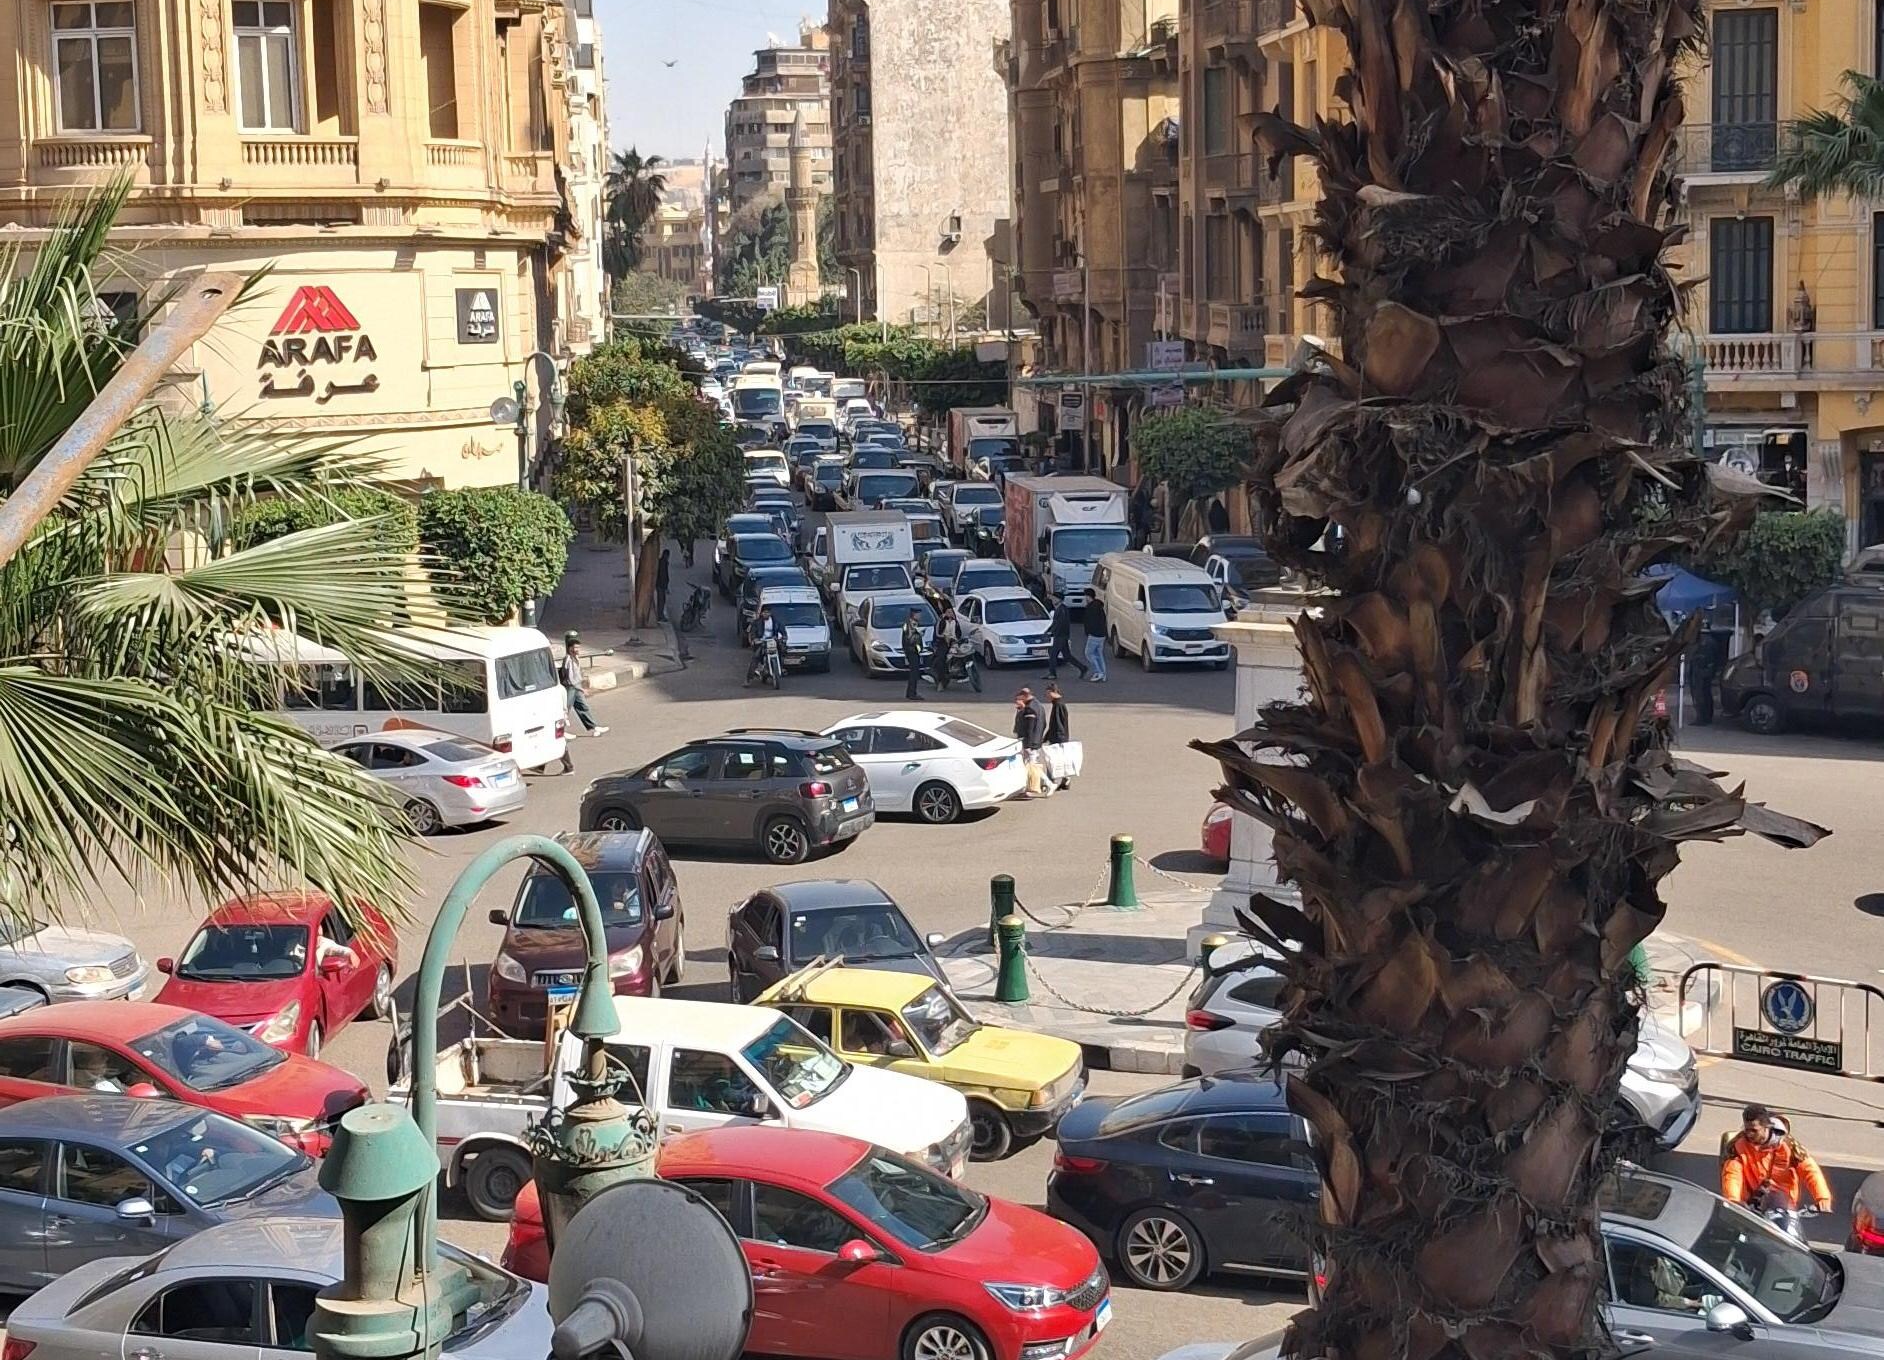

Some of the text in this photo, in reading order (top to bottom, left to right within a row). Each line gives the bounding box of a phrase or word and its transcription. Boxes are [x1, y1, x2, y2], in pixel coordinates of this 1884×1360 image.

[470, 310, 495, 322] ARAFA
[257, 334, 378, 369] ARAFA
[258, 369, 380, 405] عرفة
[1740, 1042, 1836, 1066] CAIRO TRAFFIC
